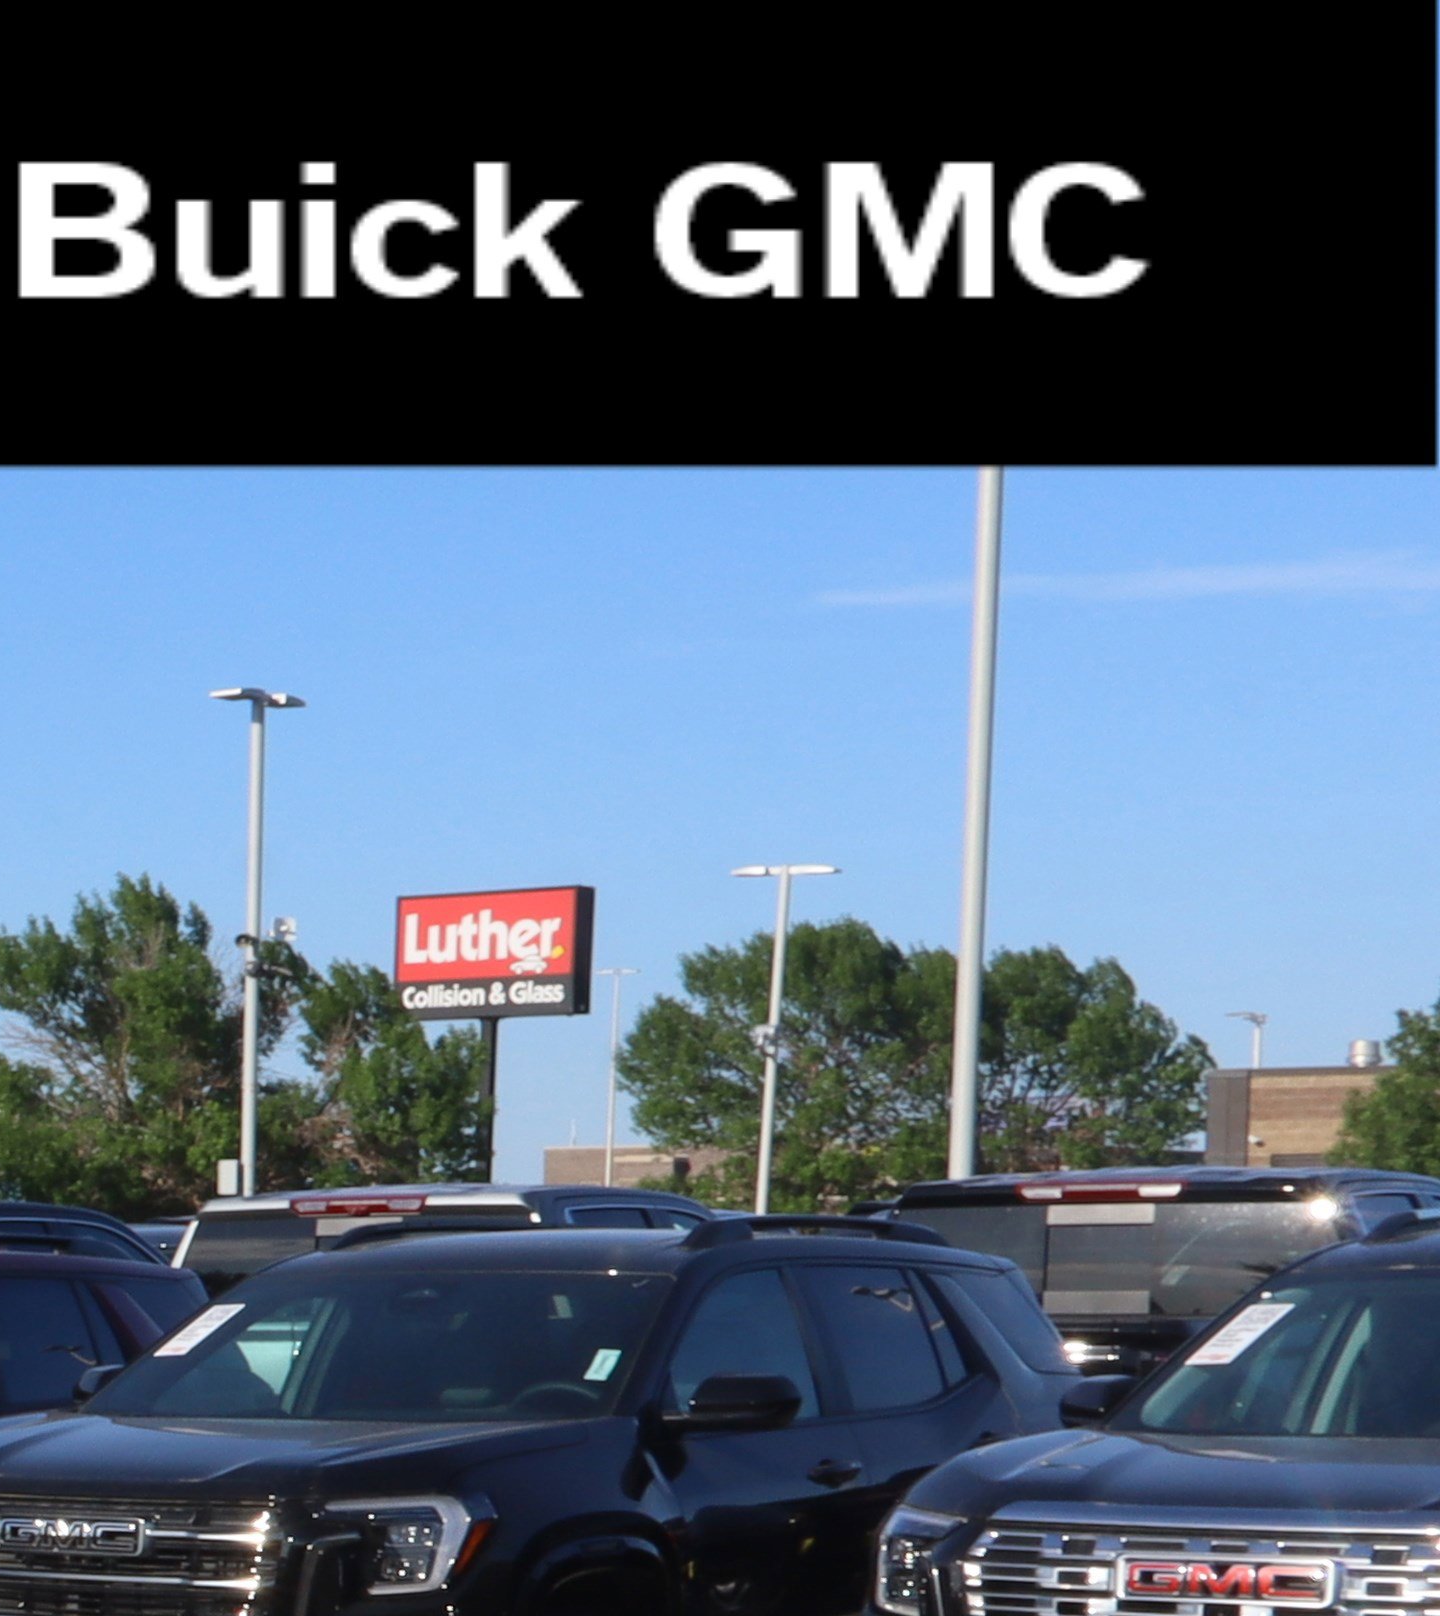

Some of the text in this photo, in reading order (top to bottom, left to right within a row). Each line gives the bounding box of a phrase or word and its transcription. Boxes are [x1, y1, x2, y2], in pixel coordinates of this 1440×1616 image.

[403, 908, 562, 965] Luther
[402, 979, 565, 1009] Collision & Glass
[0, 1517, 137, 1551] GMC
[1127, 1561, 1327, 1601] GMC
